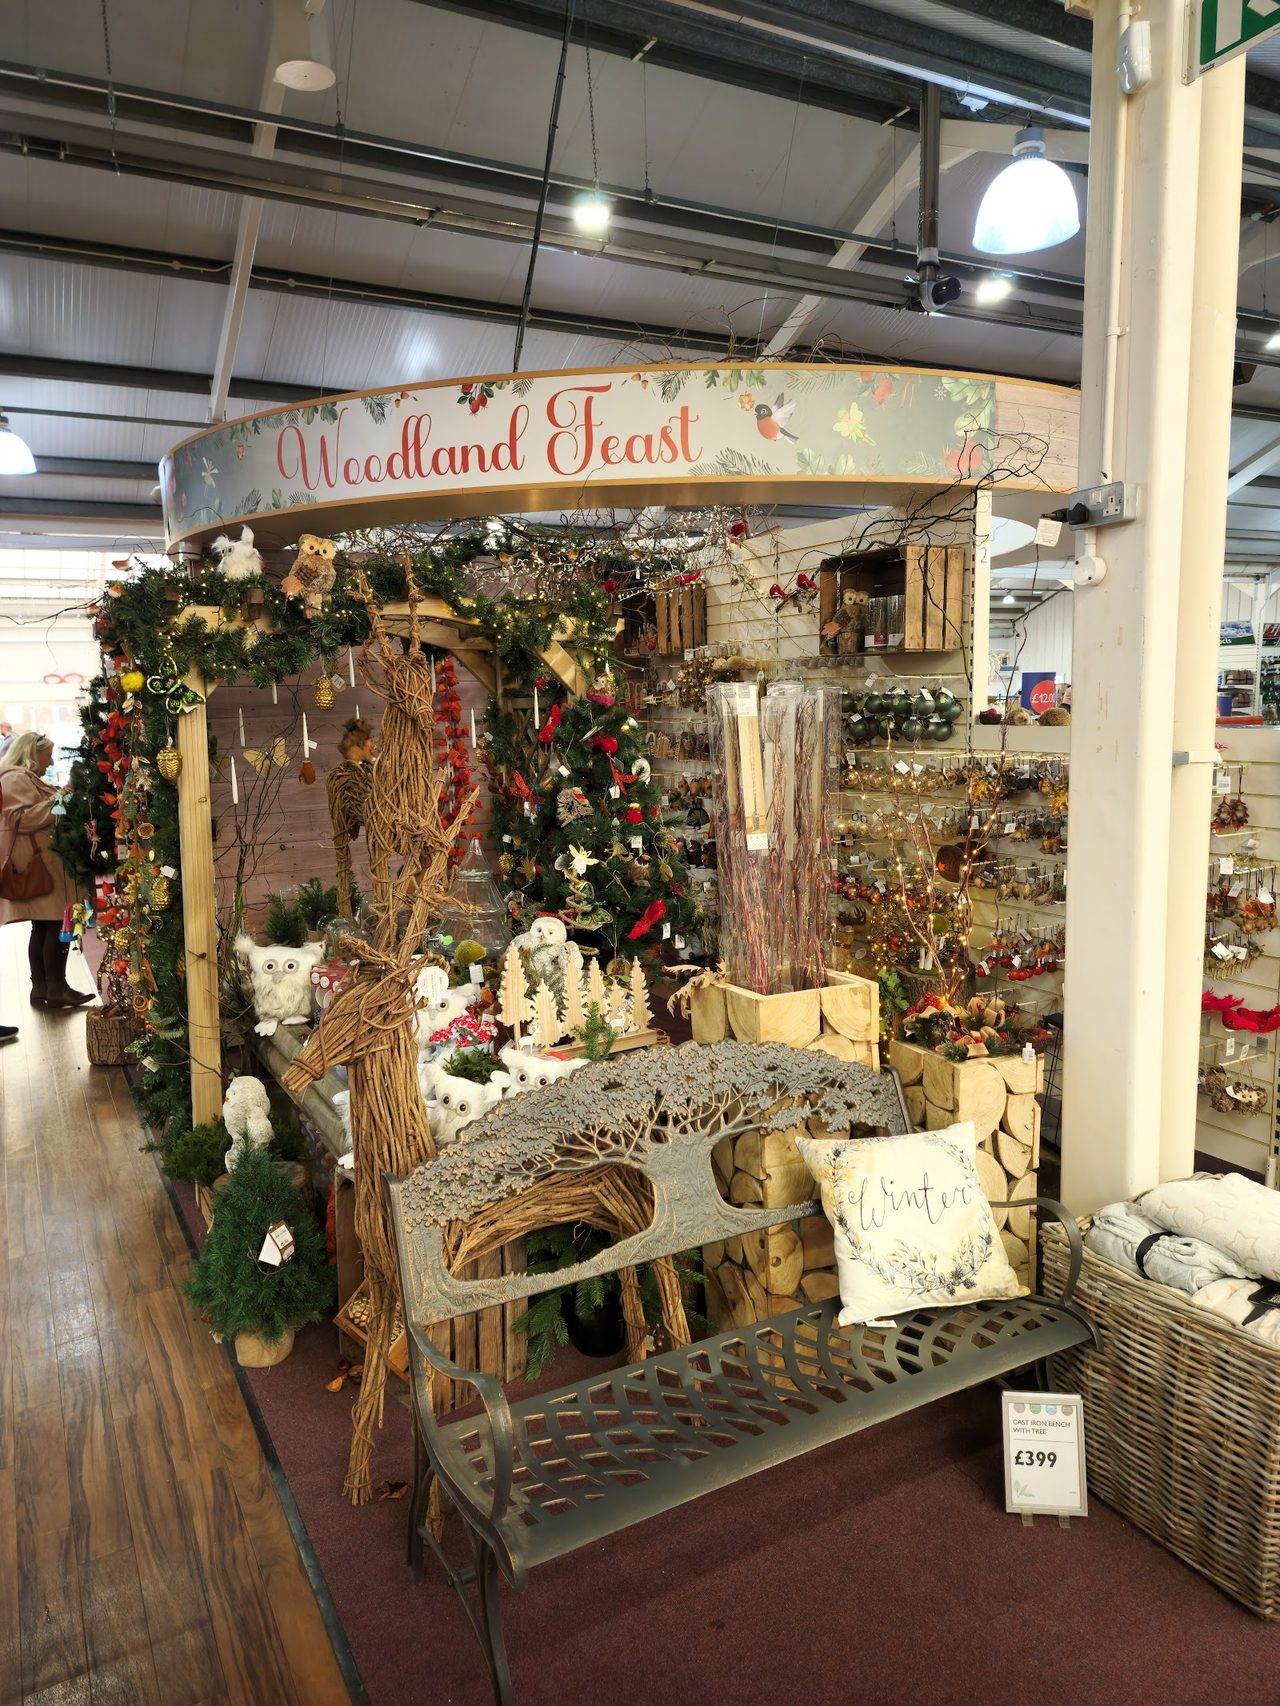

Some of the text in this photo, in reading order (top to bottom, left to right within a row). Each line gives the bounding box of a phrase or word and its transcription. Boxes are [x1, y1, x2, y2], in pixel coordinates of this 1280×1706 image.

[277, 381, 703, 491] Woodland Feast
[848, 1172, 972, 1231] Winter
[1012, 1418, 1071, 1428] CAST IRON BENCH
[1014, 1450, 1057, 1467] £399
